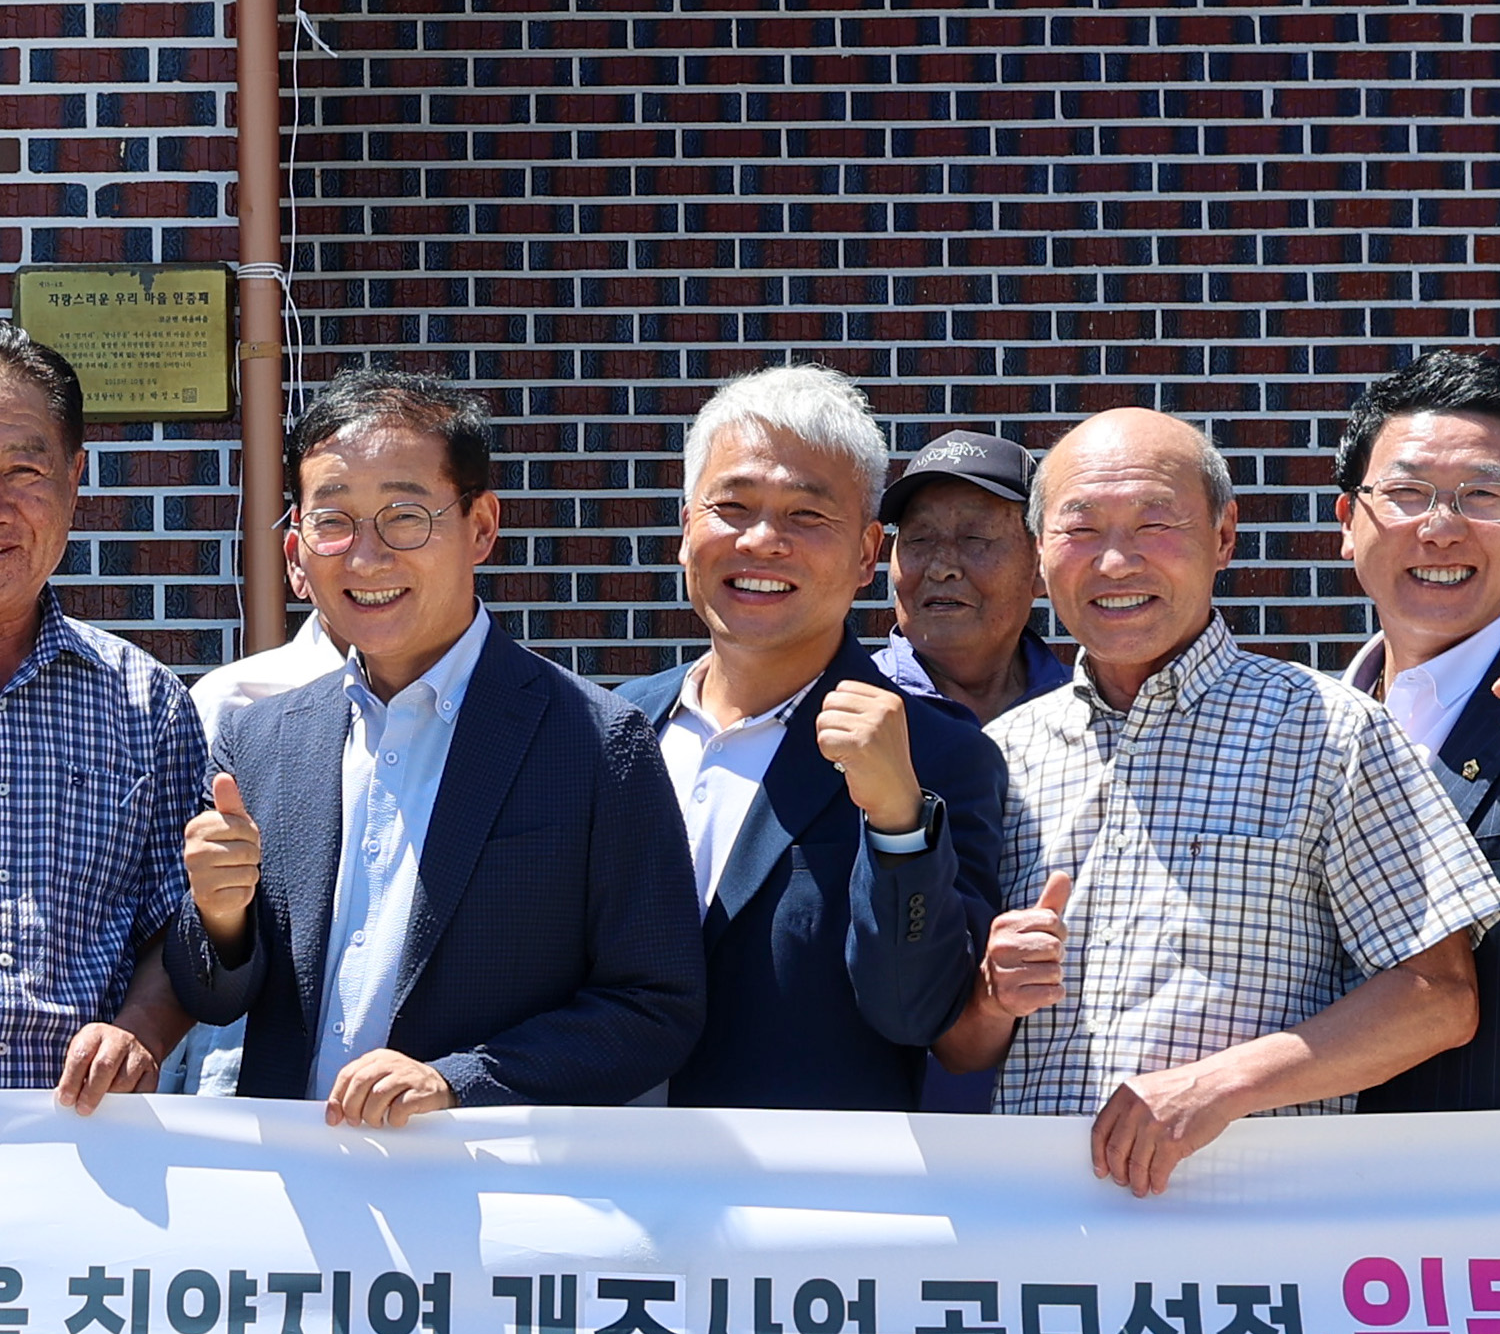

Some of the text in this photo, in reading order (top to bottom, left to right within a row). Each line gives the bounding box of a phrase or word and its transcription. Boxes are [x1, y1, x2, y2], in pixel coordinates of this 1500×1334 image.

[48, 292, 209, 307] 자랑스러운 우리 마을 인증패
